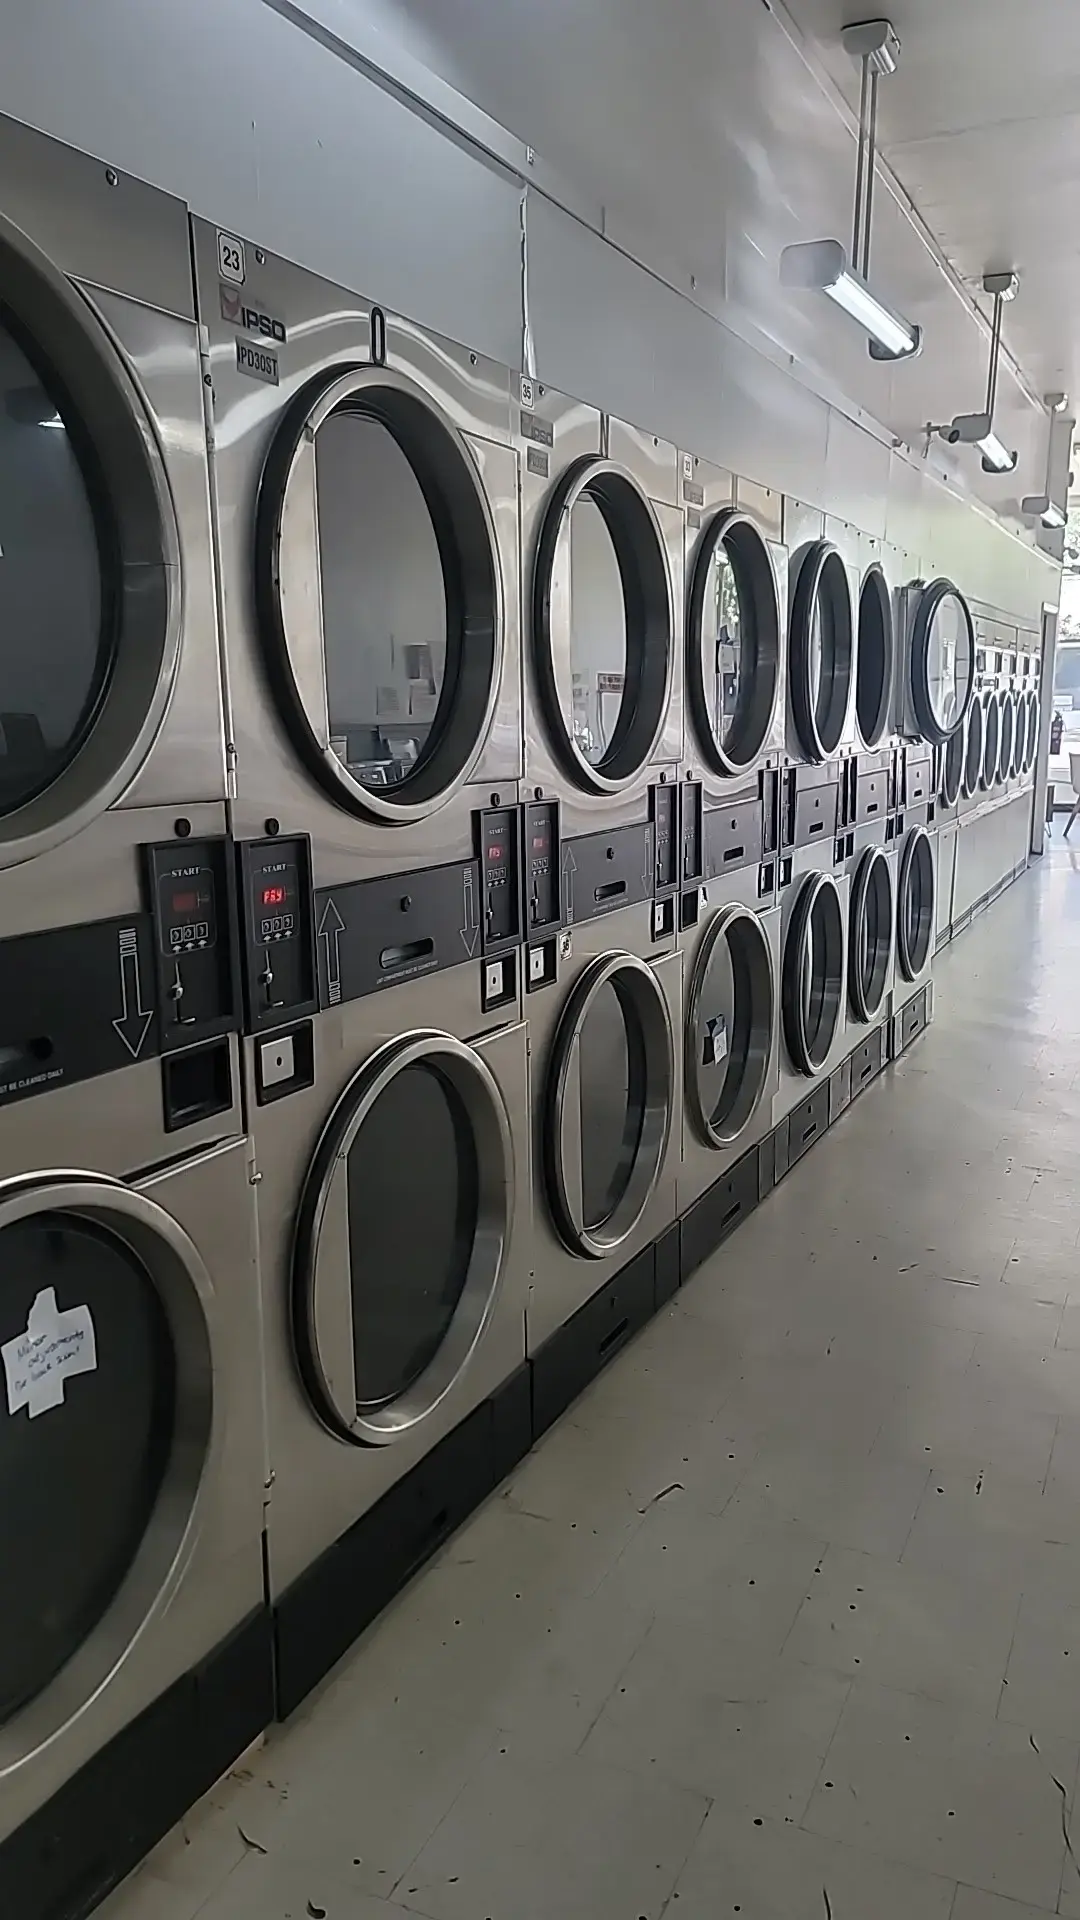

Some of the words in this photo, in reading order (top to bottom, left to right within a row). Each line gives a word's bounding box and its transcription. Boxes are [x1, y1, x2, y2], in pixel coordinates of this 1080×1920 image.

[222, 245, 240, 271] 23
[241, 306, 287, 344] IPSO
[522, 383, 532, 400] 35
[171, 867, 201, 878] START
[263, 864, 286, 873] START
